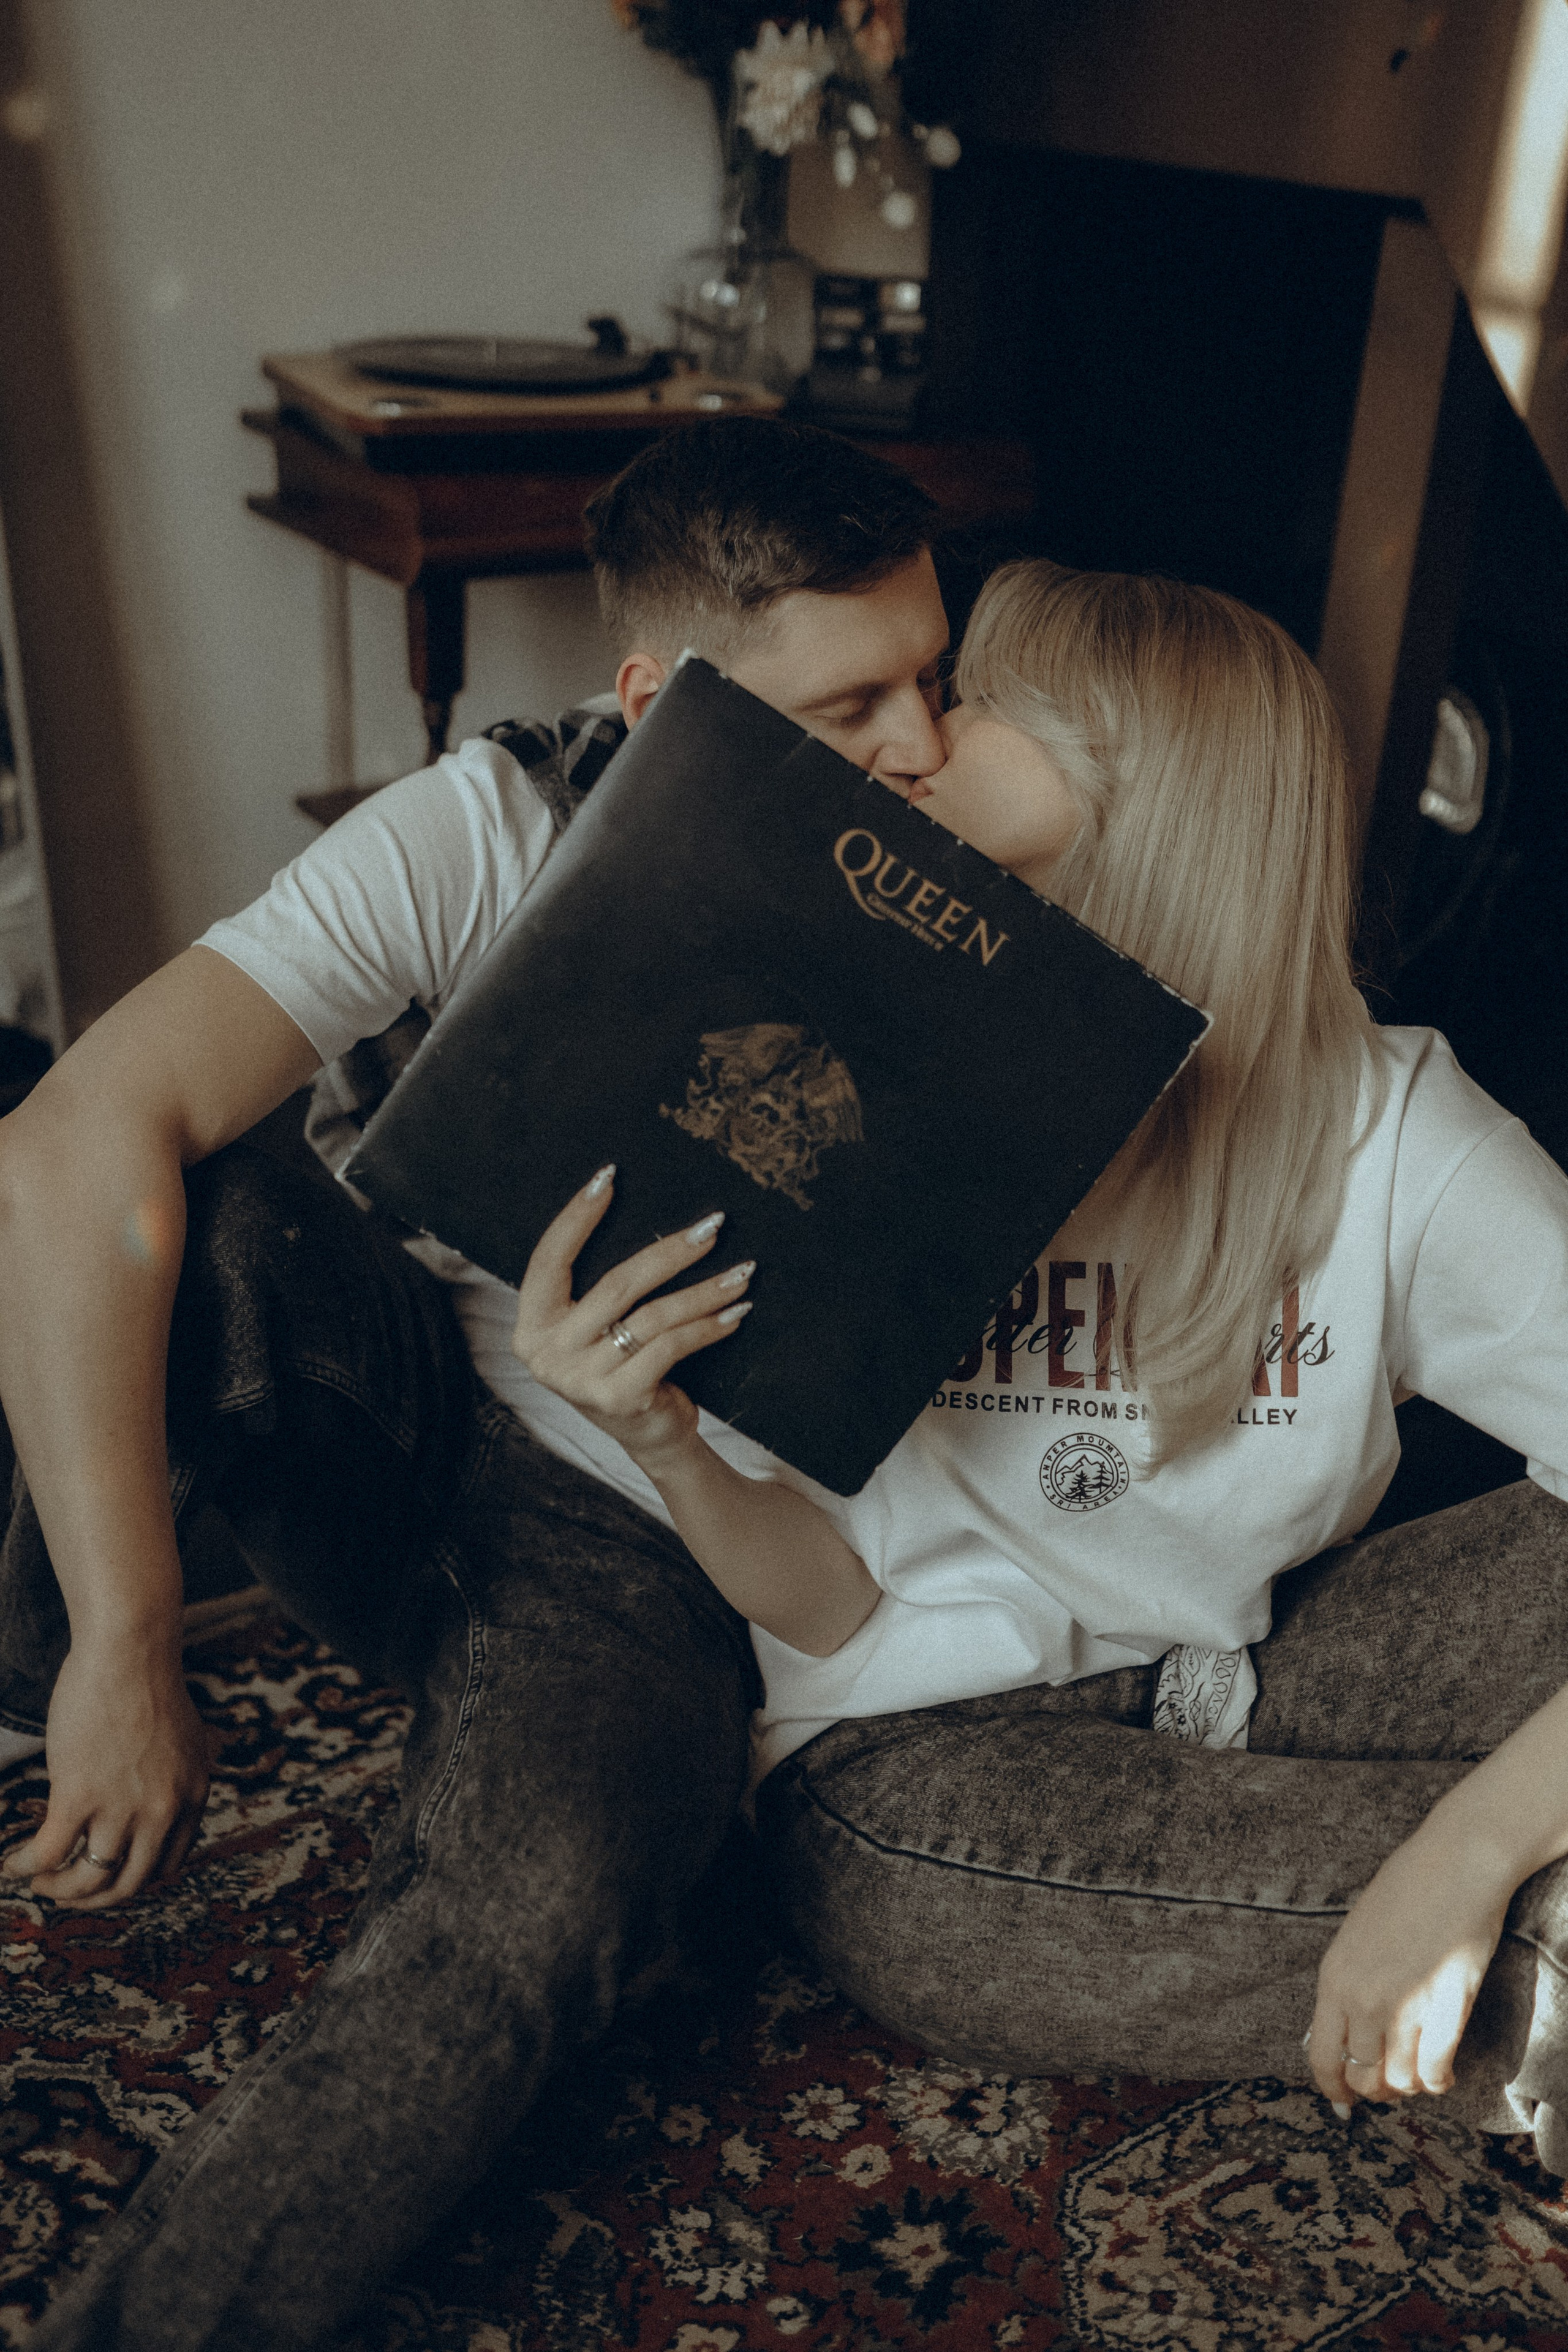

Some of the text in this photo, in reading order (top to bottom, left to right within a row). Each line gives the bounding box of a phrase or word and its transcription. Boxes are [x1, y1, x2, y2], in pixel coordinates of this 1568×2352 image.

[833, 828, 1010, 966] QUEEN
[932, 1390, 1045, 1413] DESCENT
[1052, 1398, 1117, 1420] FROM
[1231, 1408, 1298, 1425] LLEY
[1082, 1491, 1119, 1510] AREA
